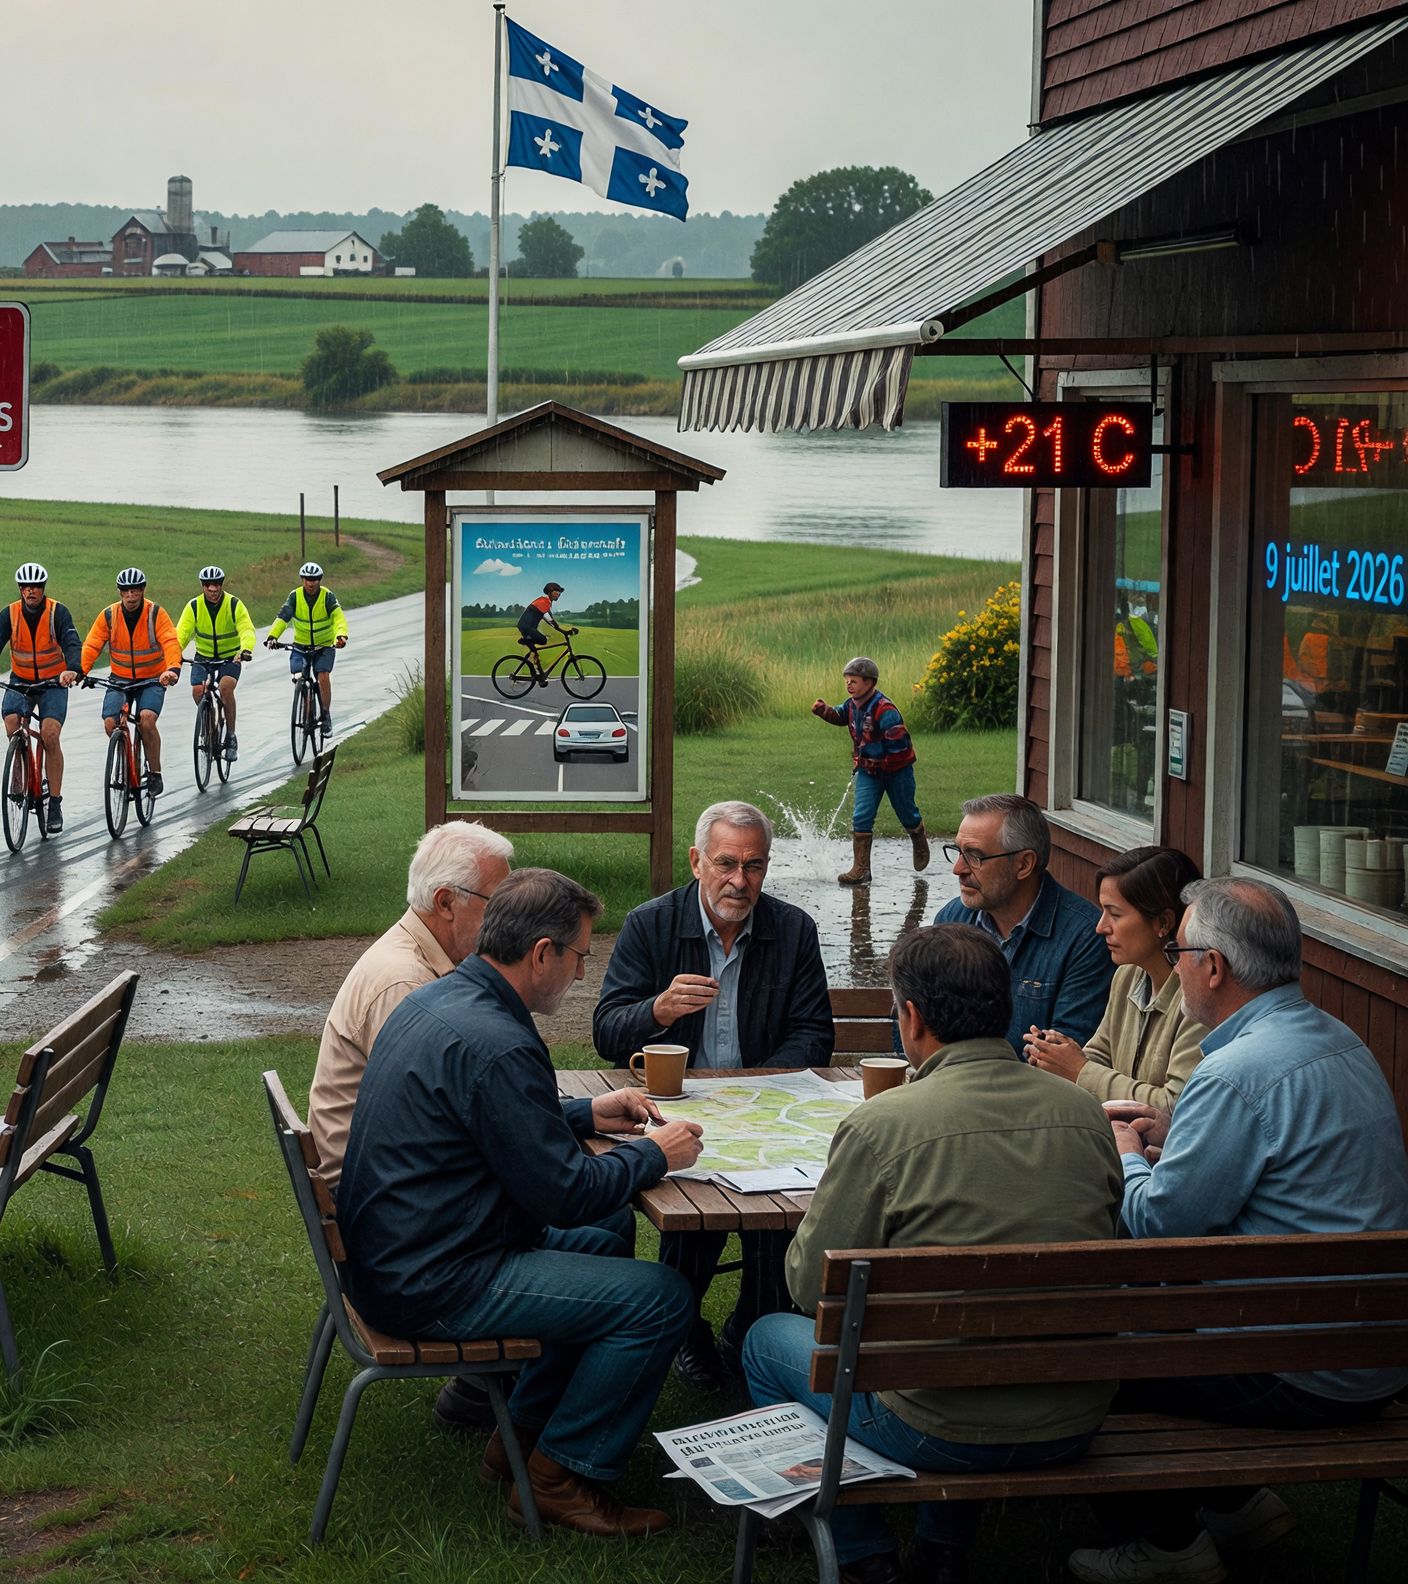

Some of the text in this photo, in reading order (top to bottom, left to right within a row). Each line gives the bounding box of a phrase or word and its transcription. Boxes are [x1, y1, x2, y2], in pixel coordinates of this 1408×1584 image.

[966, 415, 1134, 474] +21 C
[1265, 542, 1405, 606] 9 juillet 2026
